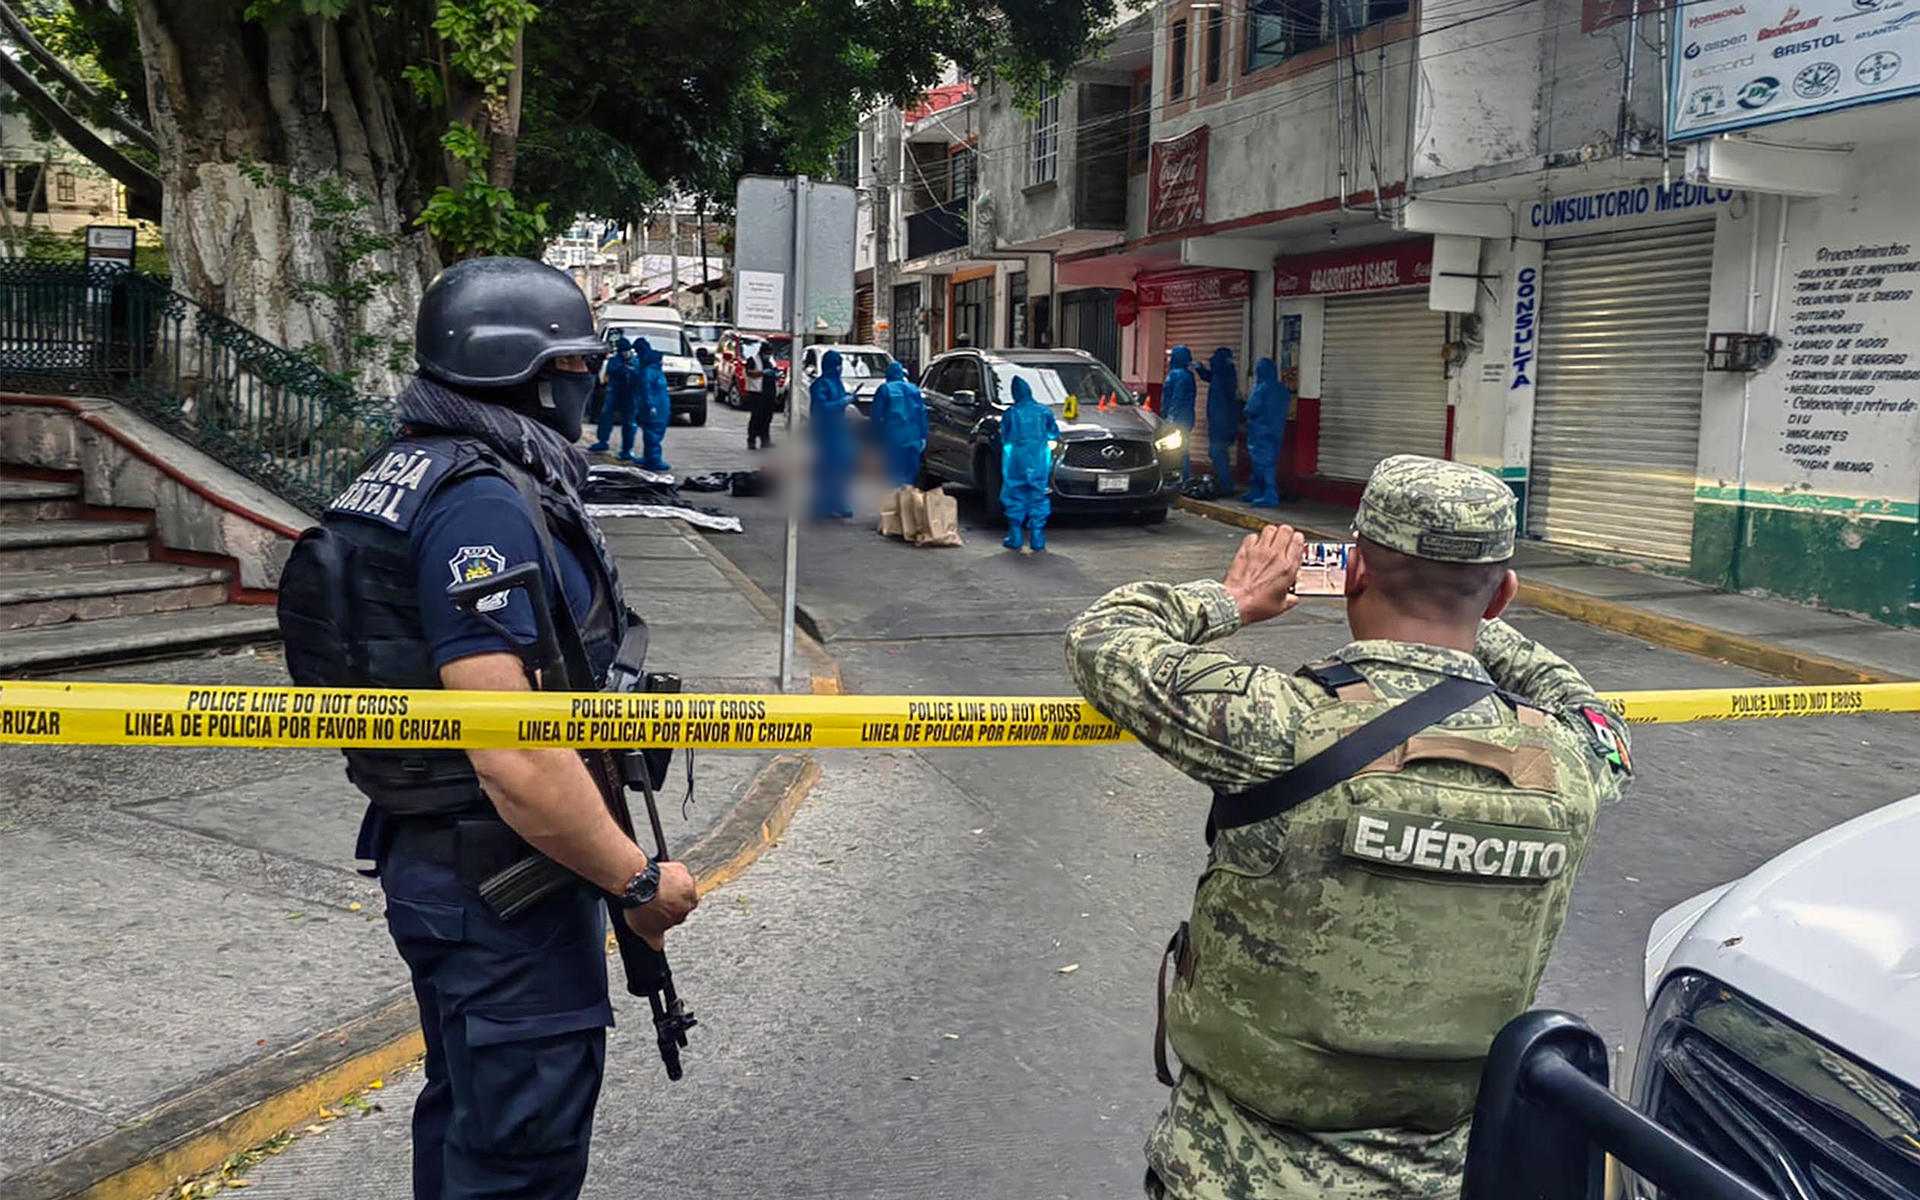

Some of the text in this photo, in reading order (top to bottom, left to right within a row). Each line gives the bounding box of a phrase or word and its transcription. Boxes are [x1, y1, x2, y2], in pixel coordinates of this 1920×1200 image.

[1773, 33, 1845, 59] BRISTOL
[1531, 187, 1650, 228] CONSULTORIO
[1365, 260, 1400, 287] ISABEL
[1511, 267, 1536, 390] CONSULTA
[1793, 339, 1834, 350] LAVADO
[1836, 338, 1852, 349] DE
[1792, 354, 1830, 366] RETIRO
[1832, 353, 1848, 366] DE
[1787, 414, 1812, 425] DIU
[1786, 429, 1849, 442] IMPLANTES
[1784, 443, 1832, 456] SONDAS
[186, 690, 409, 715] POLICE LINE DO NOT CROSS
[572, 698, 766, 719] POLICE LINE DO NOT CROSS
[908, 702, 1081, 722] POLICE LINE DO NOT CROSS
[1731, 691, 1863, 713] POLICE LINE DO NOT CROSS
[0, 709, 61, 736] RUZAR
[125, 712, 461, 741] LINEA DE POLICIA POR FAVOR NO CRUZAR
[518, 720, 812, 743] LINEA DE POLICIA POR FAVOR NO CRUZAR
[861, 722, 1122, 742] LINEA DE POLICIA POR FAVOR NO CRUZAR
[1354, 815, 1567, 878] EJÉRCITO
